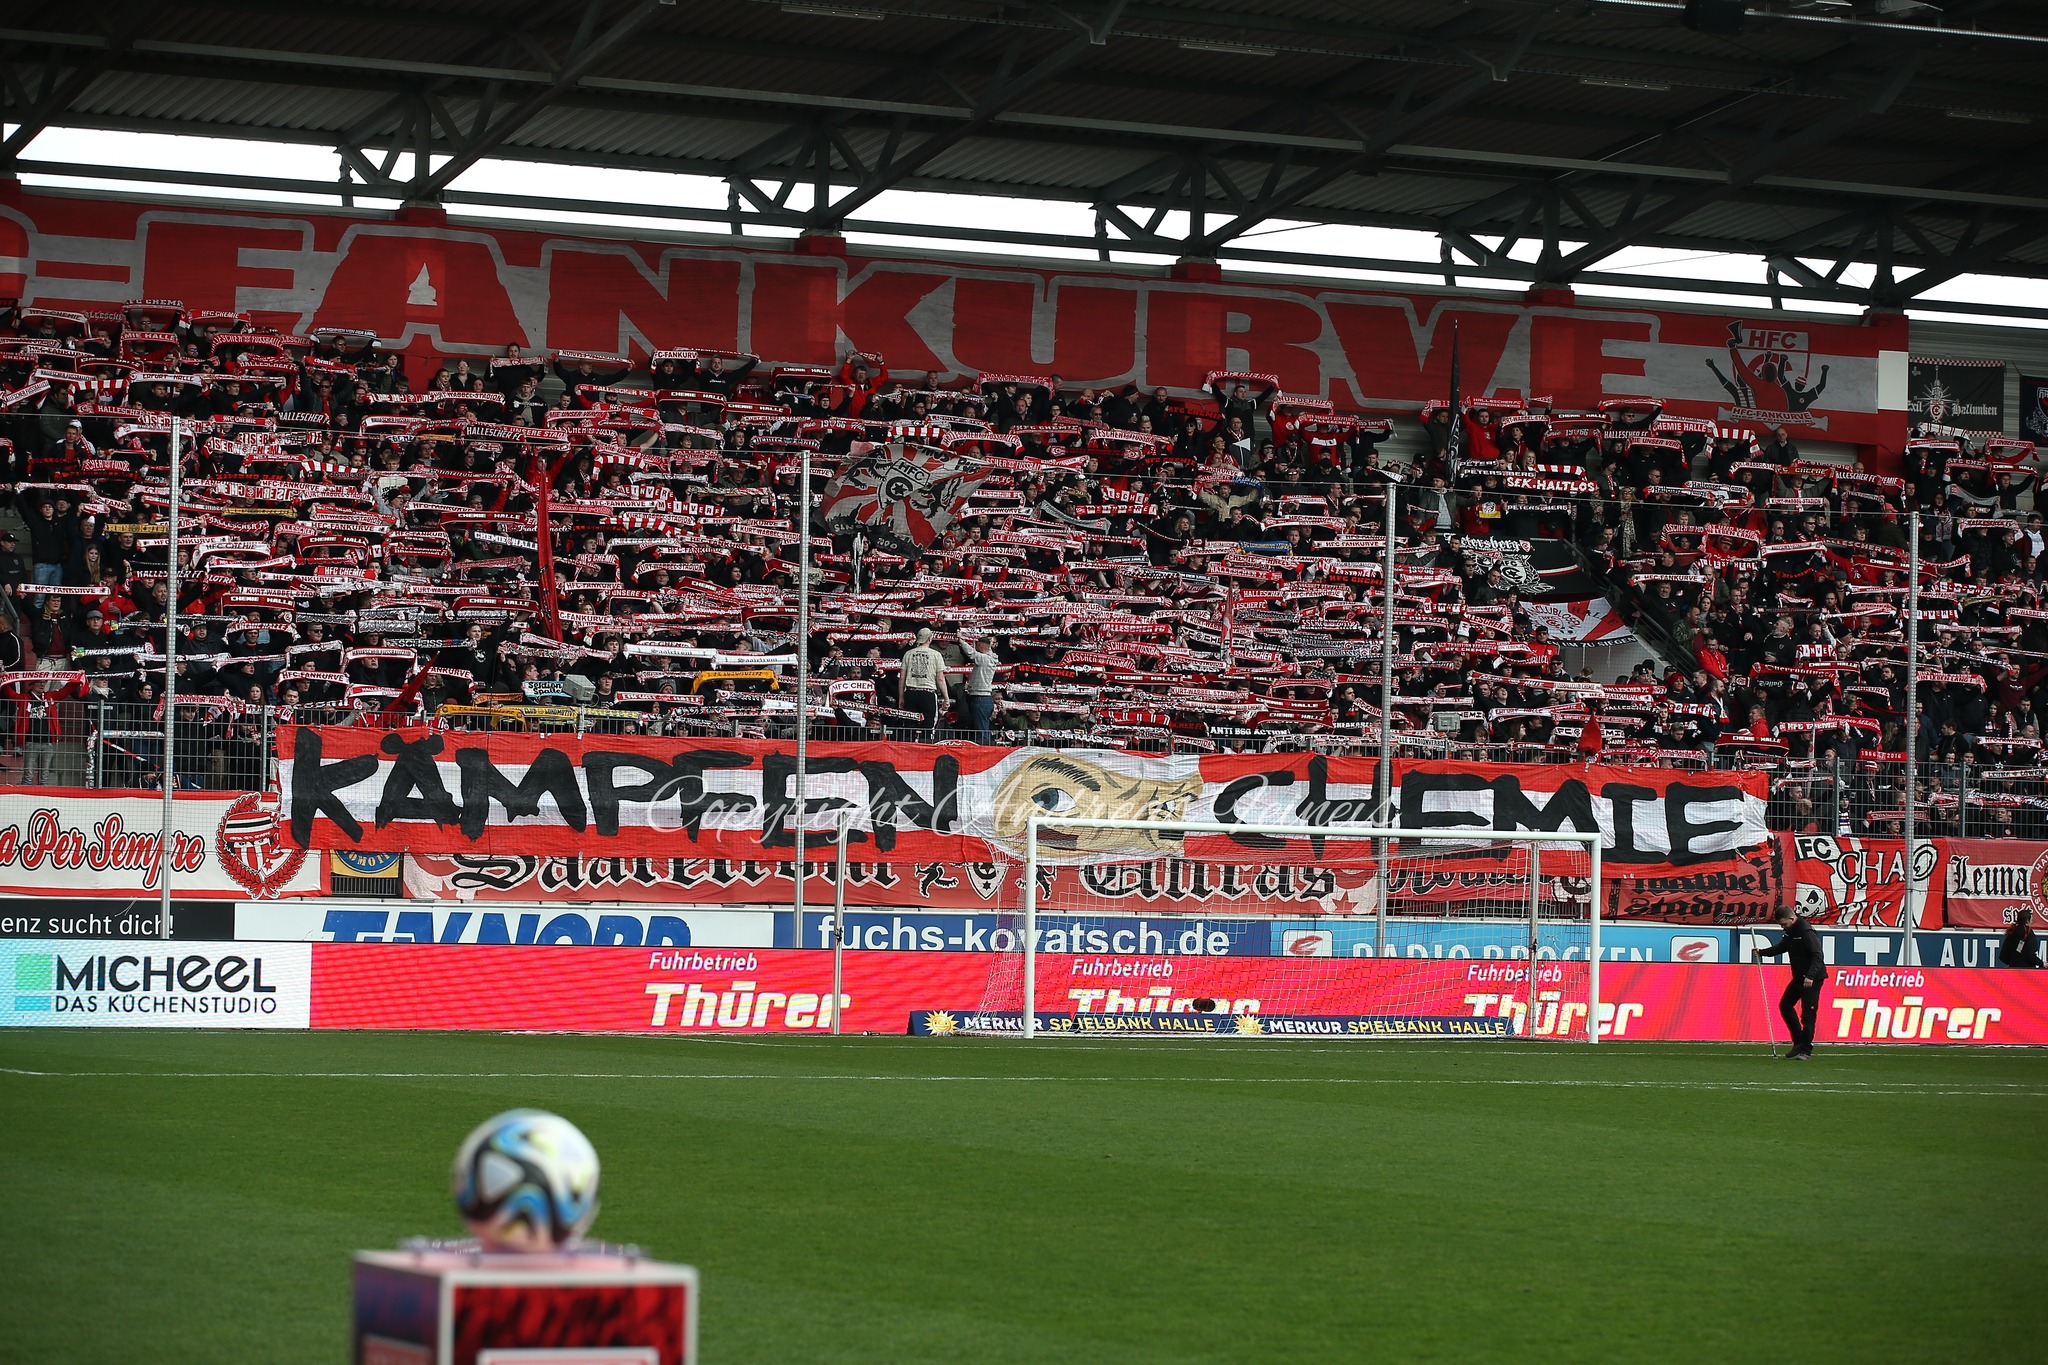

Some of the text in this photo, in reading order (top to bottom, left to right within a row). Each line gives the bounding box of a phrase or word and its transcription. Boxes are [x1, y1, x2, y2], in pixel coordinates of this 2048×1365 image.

[217, 311, 239, 319] CHEMIE
[1749, 331, 1797, 350] HFC
[314, 358, 334, 367] chemie
[1215, 370, 1278, 382] HFC CHEMIE
[610, 403, 645, 415] HFC CHEMIE
[728, 403, 754, 411] CHEMIE
[1951, 402, 1998, 417] Hallunken
[236, 416, 258, 424] CHEMIE
[279, 411, 322, 423] HALLESCHER
[1732, 408, 1812, 423] HFC-FANKURVE
[1653, 421, 1707, 433] CHEMIE HALLE
[466, 427, 523, 441] HALLESCHER FC
[898, 461, 926, 482] HFC
[311, 523, 375, 532] HFC-FANKURVE
[474, 531, 505, 542] CHEMIE
[592, 555, 617, 564] CHEMIE
[1870, 558, 1894, 566] CHEMIE
[325, 566, 366, 577] HFC CHEMIE
[1596, 635, 1637, 648] SIEGEN
[22, 670, 50, 681] UNSER
[52, 670, 81, 680] VEREIN
[282, 670, 344, 682] HFC-FANKURVE
[1256, 697, 1283, 708] CHEMIE
[1269, 712, 1296, 720] CHEMIE
[1210, 727, 1233, 736] ANTI
[291, 727, 1744, 865] KÄMPFEN CHEMIE
[23, 808, 85, 870] Per
[88, 813, 205, 889] Sempre
[1950, 855, 2029, 898] Leuna
[49, 914, 111, 935] sucht
[120, 913, 174, 935] dich!
[818, 916, 1230, 955] fuchs-kovatsch.de
[649, 952, 757, 972] Fuhrbetrieb
[1071, 957, 1174, 978] Fuhrbetrieb
[1467, 964, 1562, 983] Fuhrbetrieb
[1836, 969, 1925, 988] Fuhrbetrieb
[56, 994, 277, 1014] DAS KÜCHENSTUDIO
[645, 980, 851, 1028] Thürer
[1832, 995, 2001, 1040] Thürer
[963, 1016, 1216, 1033] MERKUR SPIELBANK HALLE
[1270, 1019, 1506, 1036] MERKUR SPIELBANK HALLE
